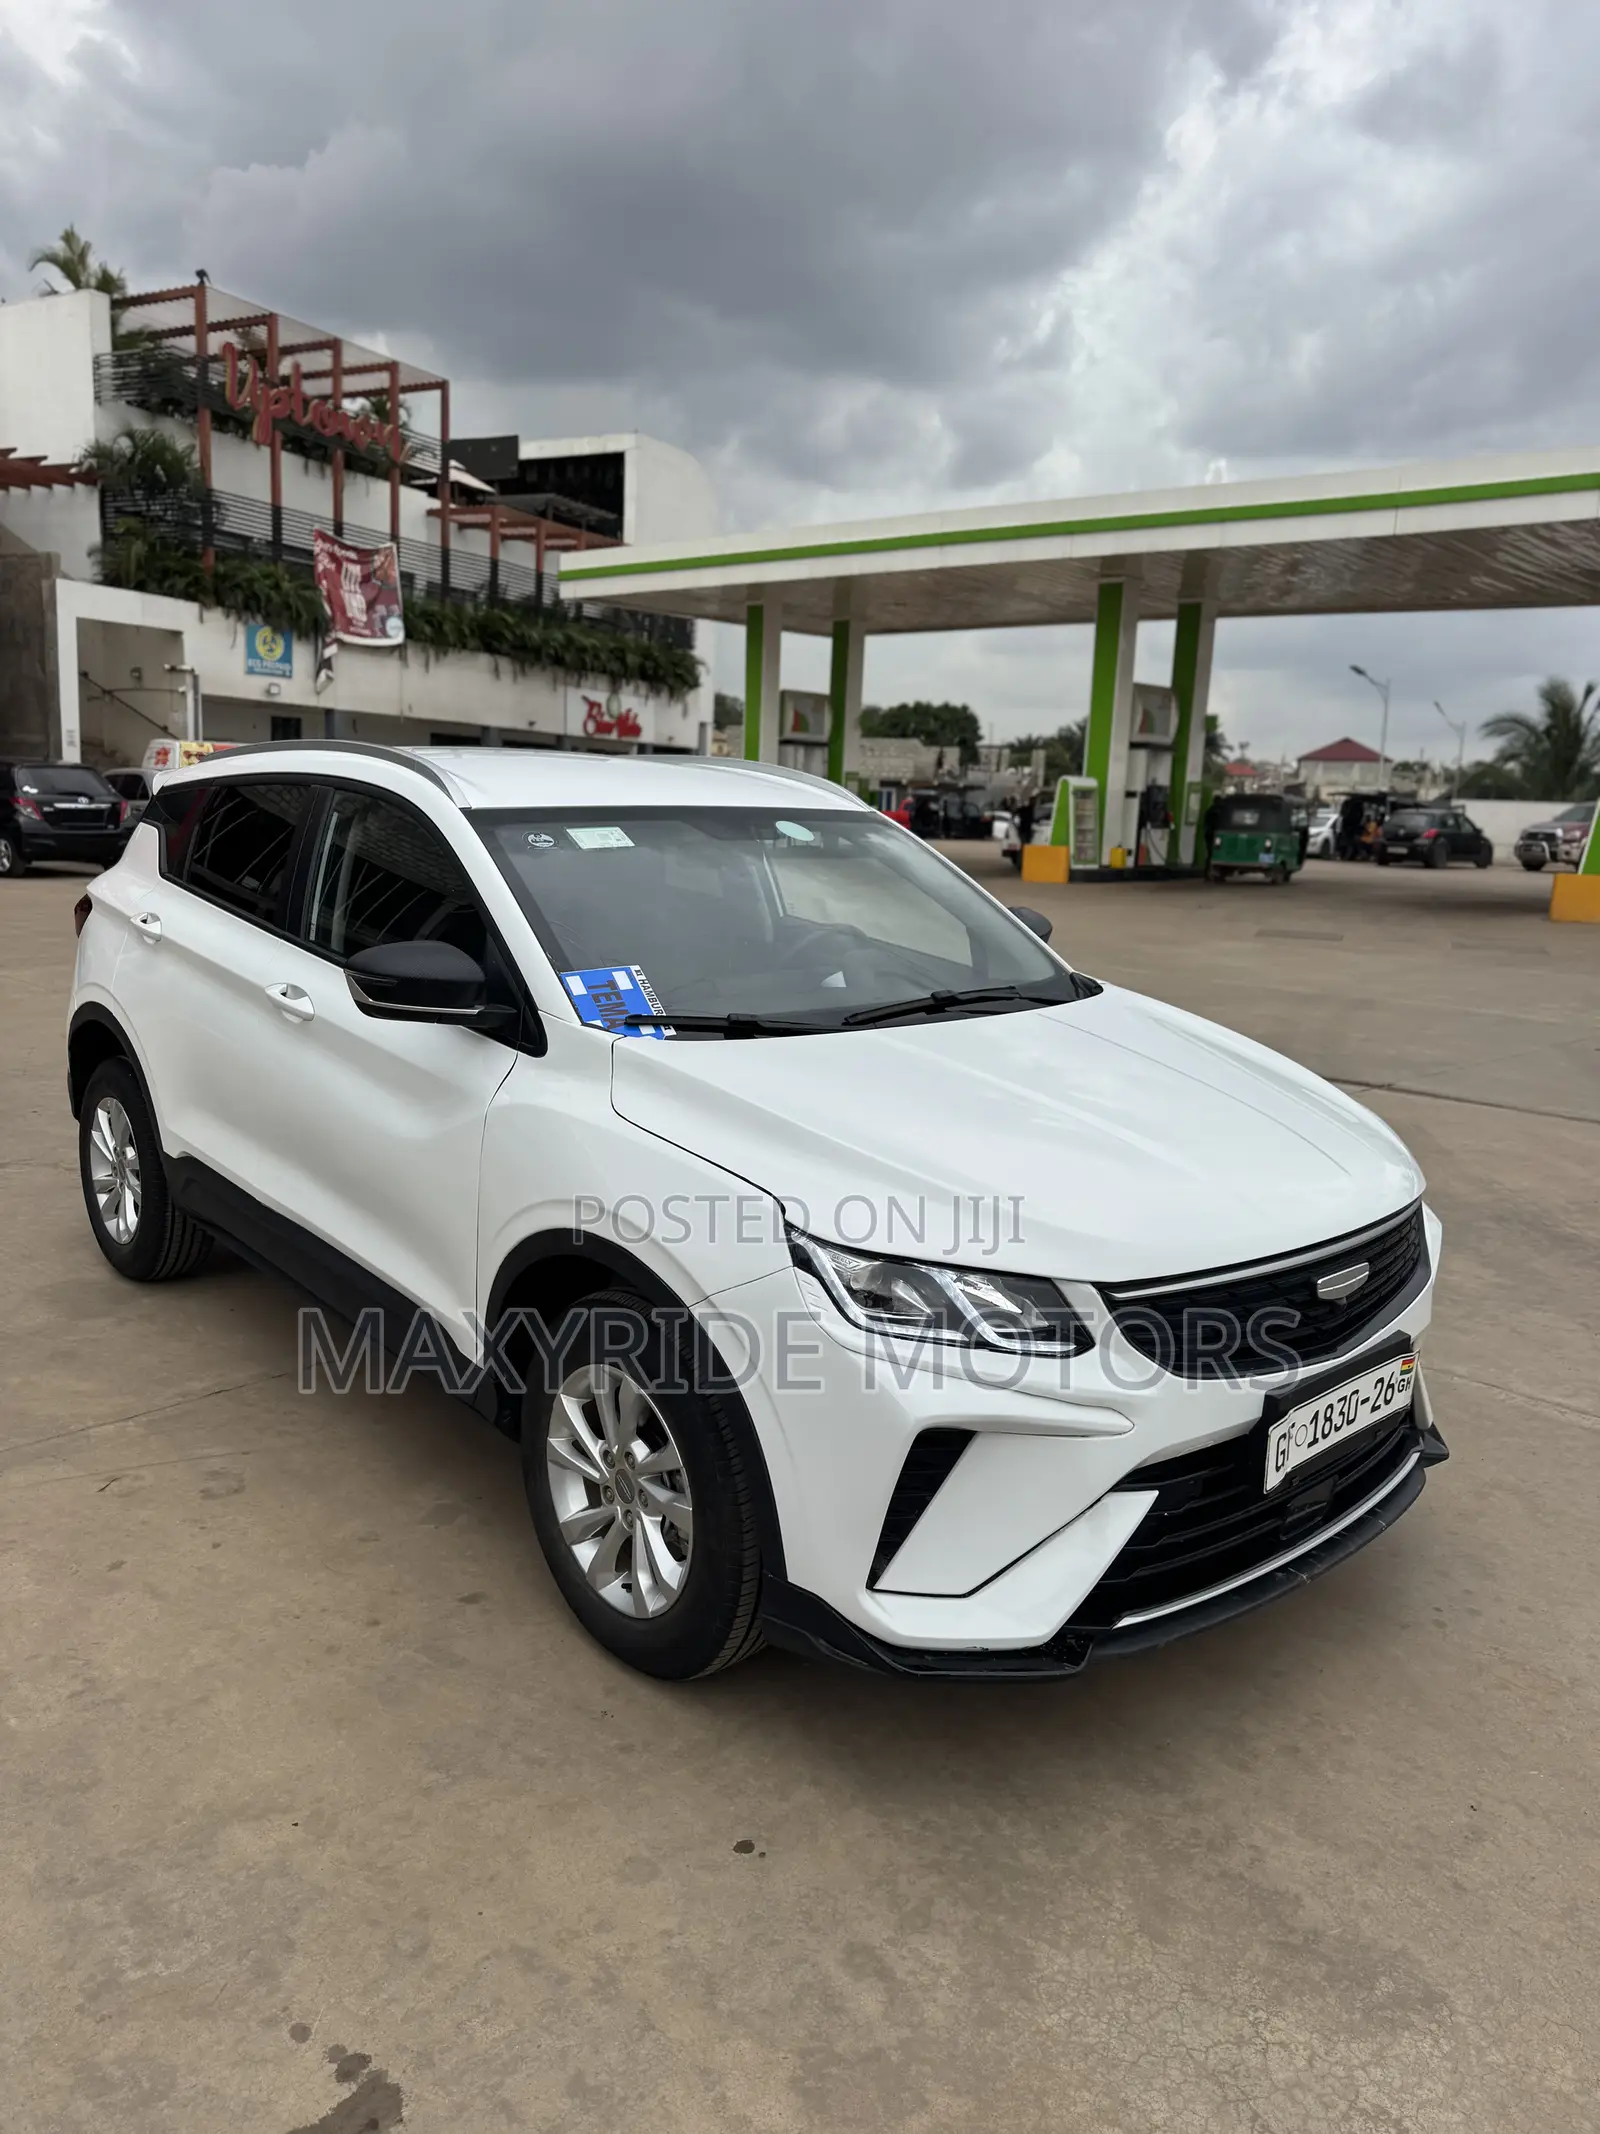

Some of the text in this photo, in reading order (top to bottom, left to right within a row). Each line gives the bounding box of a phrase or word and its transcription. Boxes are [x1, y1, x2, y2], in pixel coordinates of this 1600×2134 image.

[587, 979, 630, 1030] TEMA
[638, 979, 664, 1017] HAMBUR
[1397, 1376, 1412, 1394] GH
[1306, 1370, 1396, 1449] 1830-26
